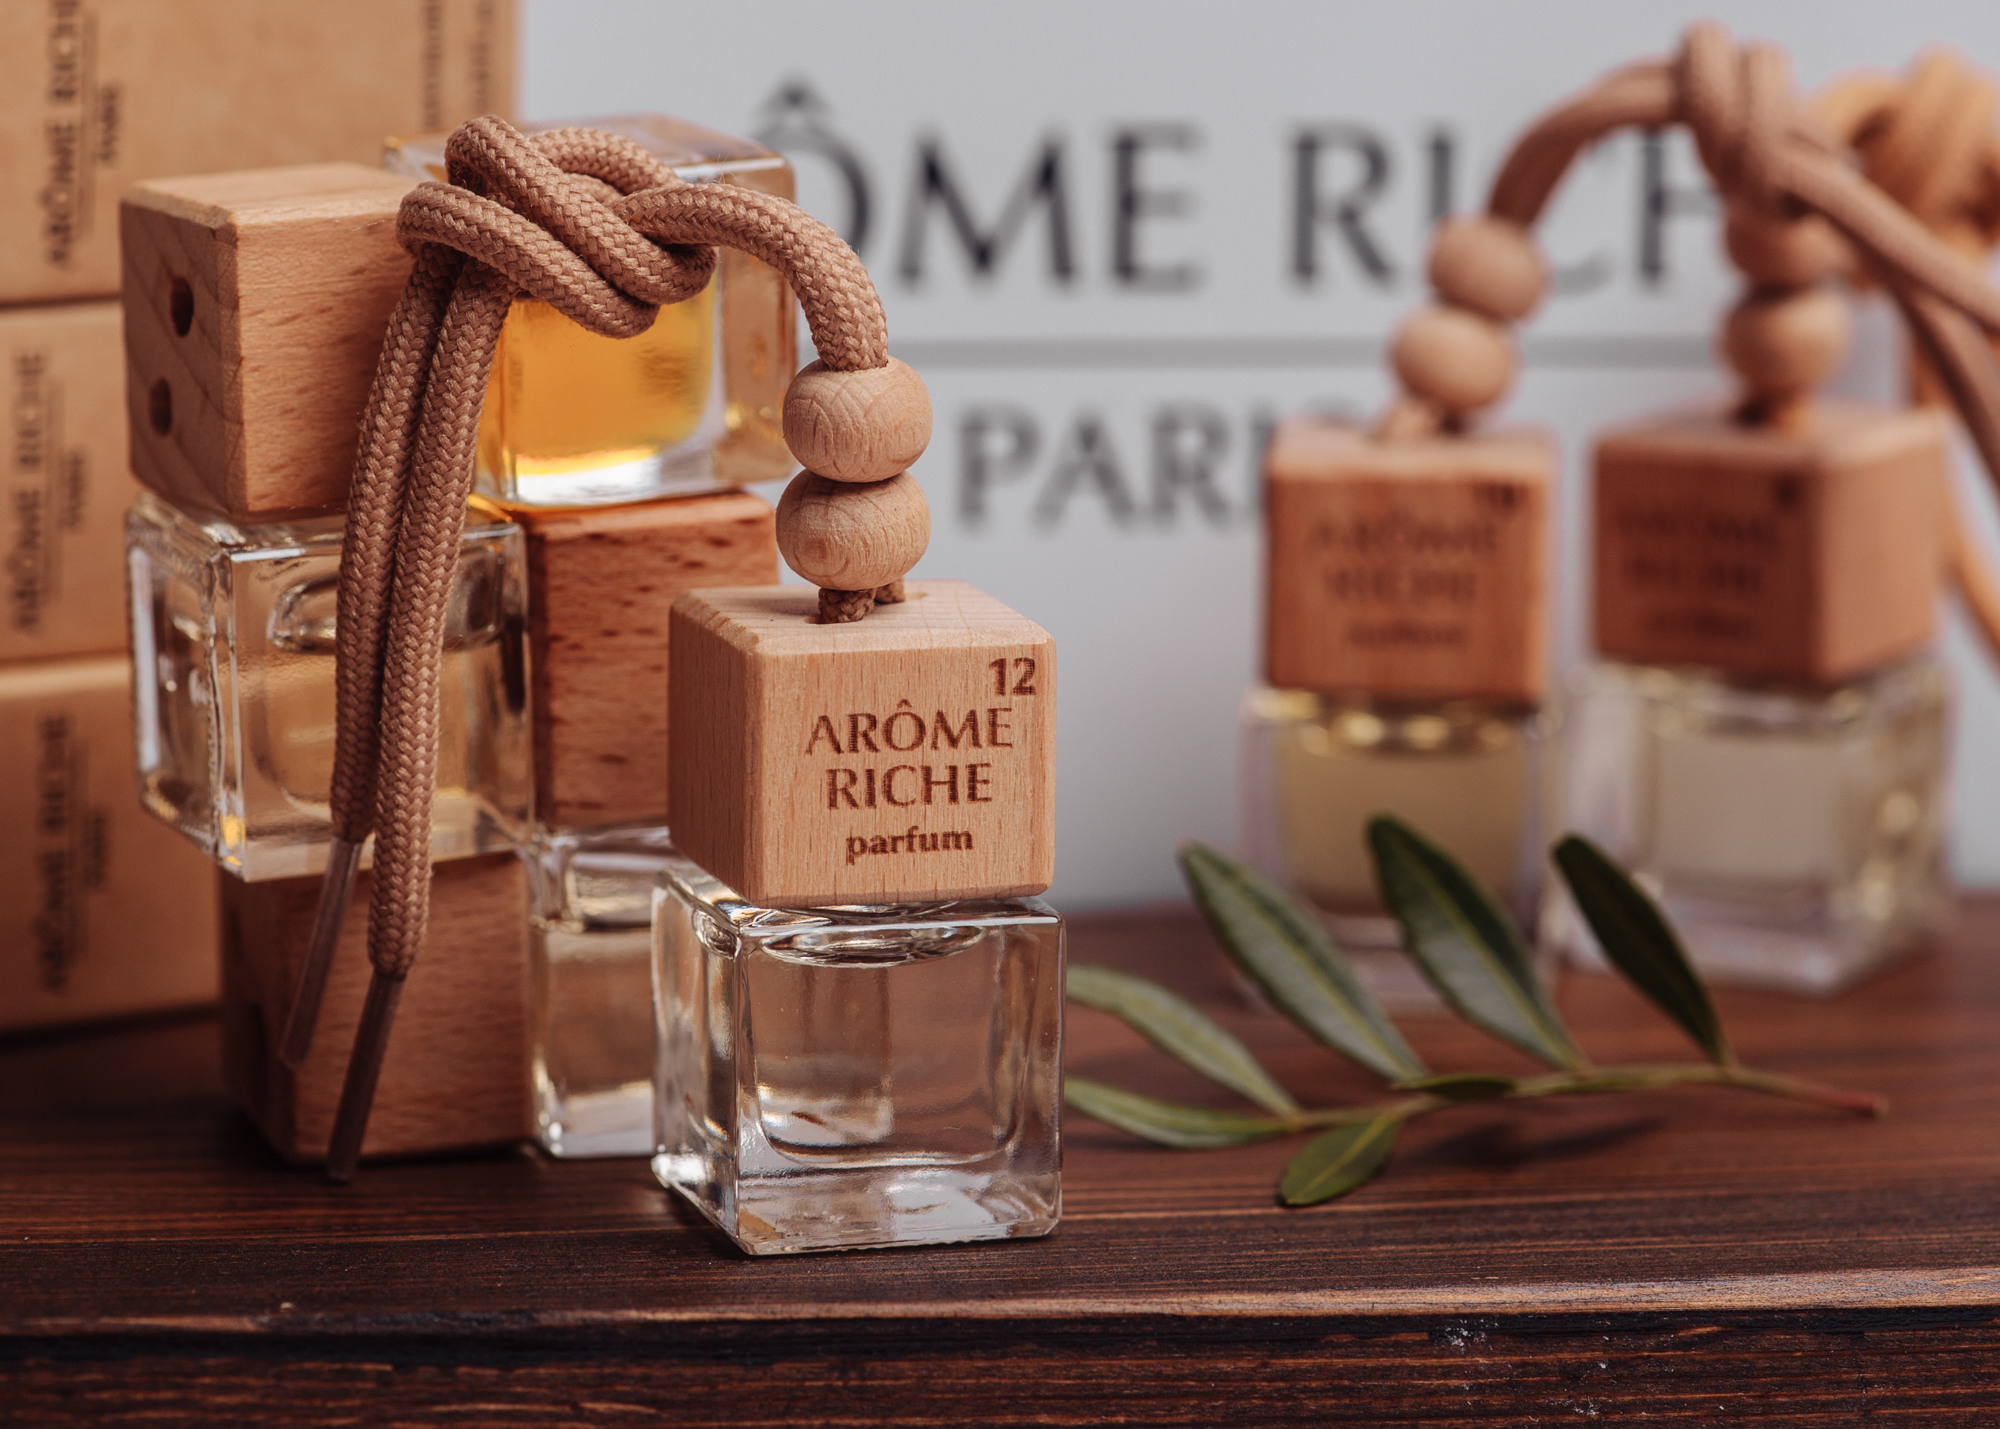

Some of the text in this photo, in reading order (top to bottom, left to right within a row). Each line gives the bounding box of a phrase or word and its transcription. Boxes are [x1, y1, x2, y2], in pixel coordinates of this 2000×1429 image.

[989, 657, 1037, 697] 12
[804, 698, 1014, 756] ARÔME
[826, 762, 993, 810] RICHE
[845, 825, 974, 866] parfum
